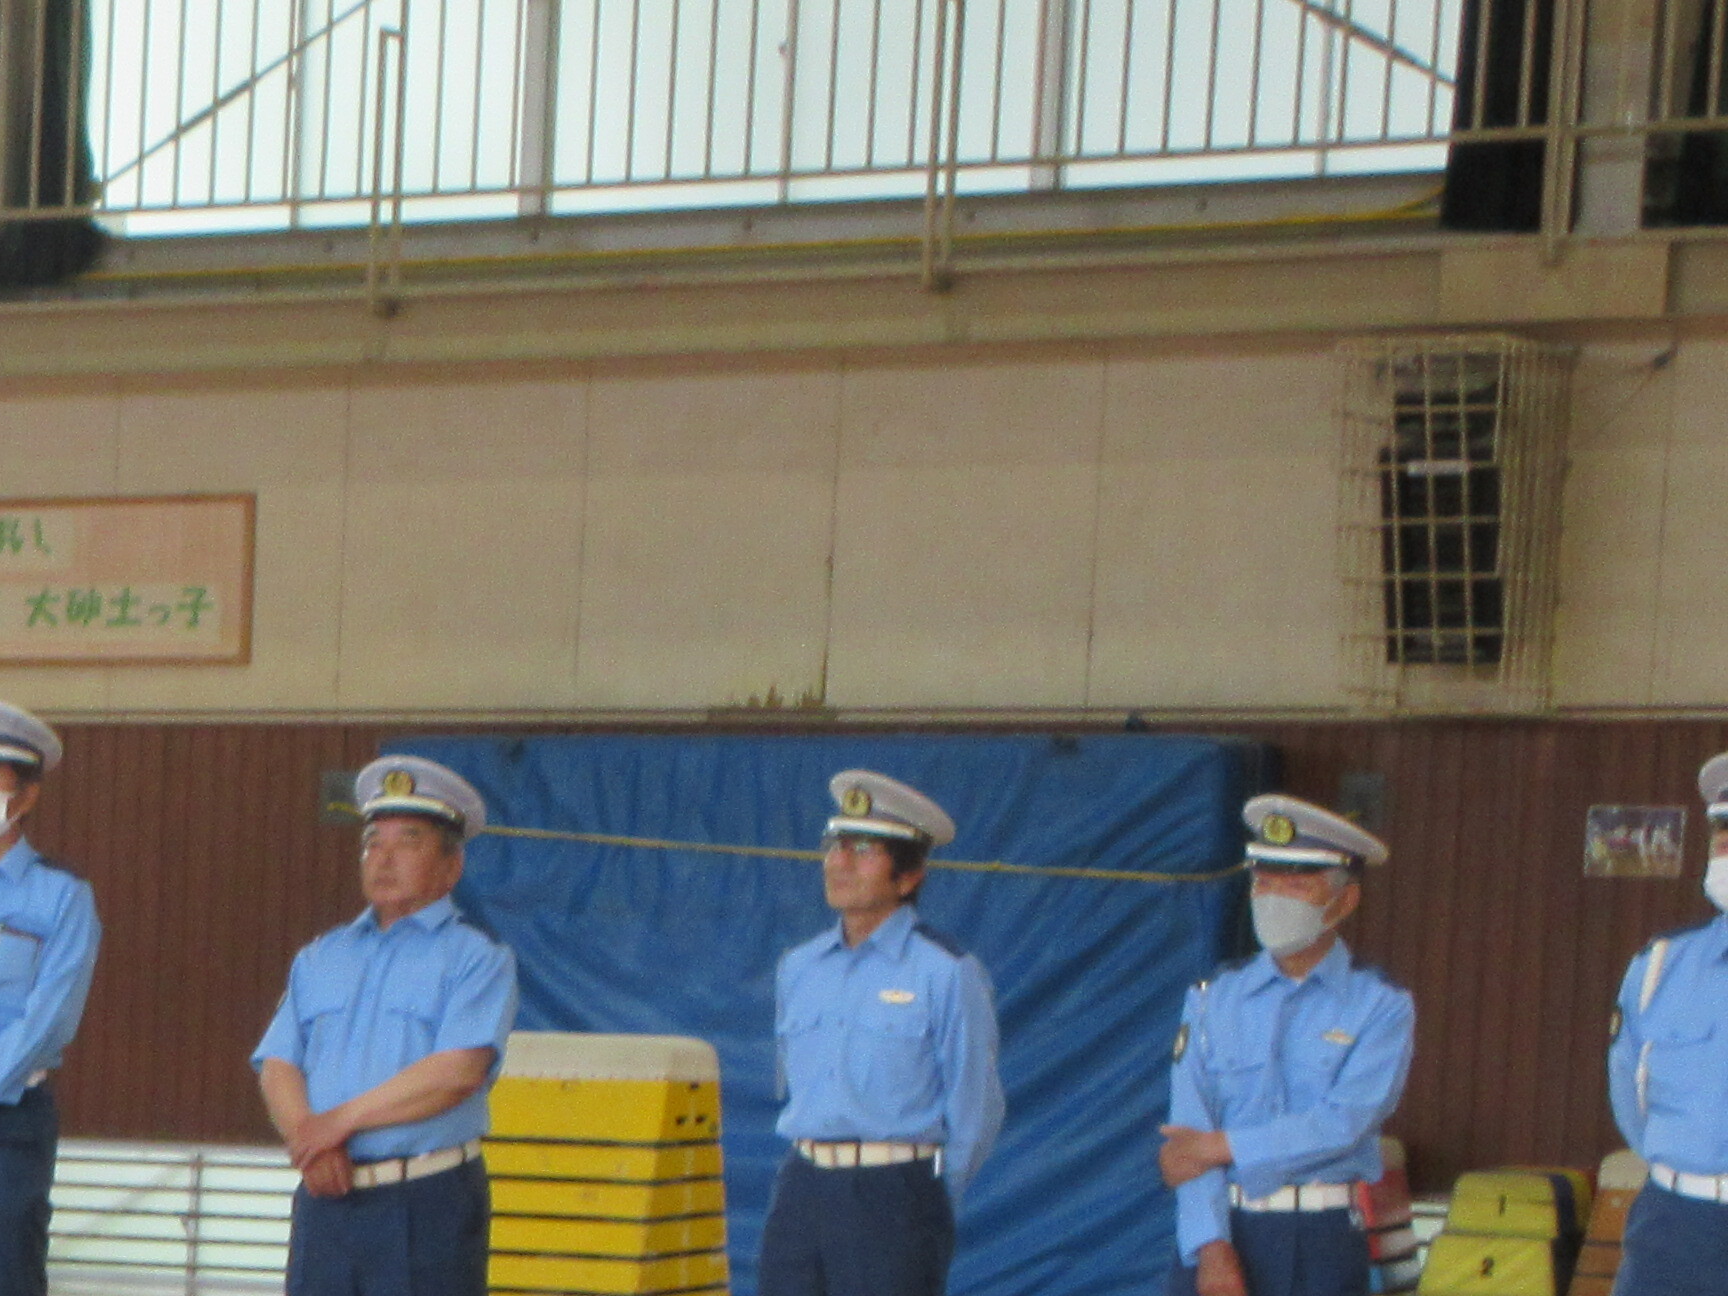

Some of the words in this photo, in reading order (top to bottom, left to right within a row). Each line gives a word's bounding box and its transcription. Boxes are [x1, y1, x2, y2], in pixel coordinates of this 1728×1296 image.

[25, 586, 215, 629] 大砂土っ子
[1480, 1256, 1494, 1278] 2
